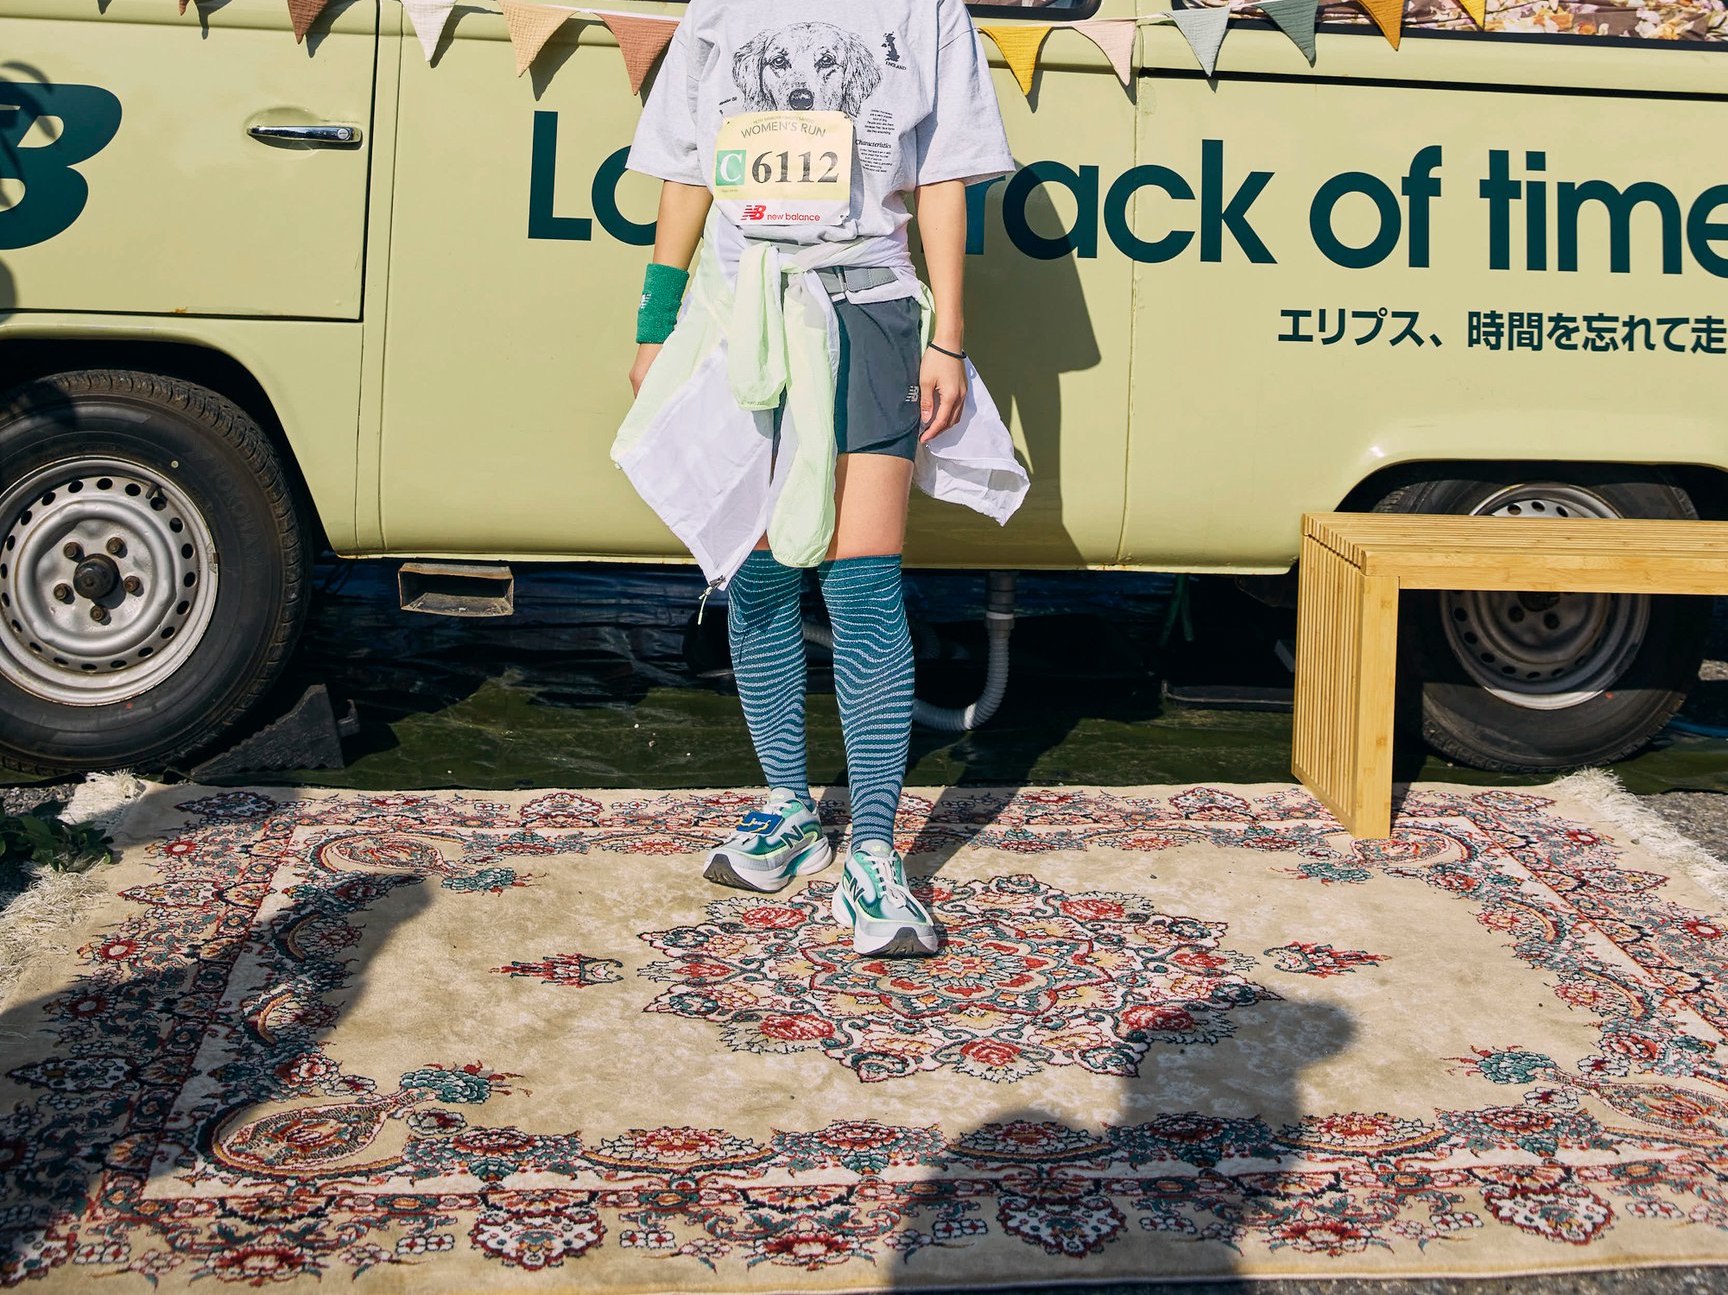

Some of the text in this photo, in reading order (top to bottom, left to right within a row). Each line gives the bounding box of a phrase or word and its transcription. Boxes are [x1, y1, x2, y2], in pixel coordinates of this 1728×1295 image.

[741, 121, 826, 139] WOMEN'S RUN
[720, 152, 742, 182] C
[752, 151, 840, 184] 6112
[963, 139, 1278, 263] rack
[1309, 145, 1442, 269] of
[767, 213, 784, 221] new
[785, 213, 821, 222] balance
